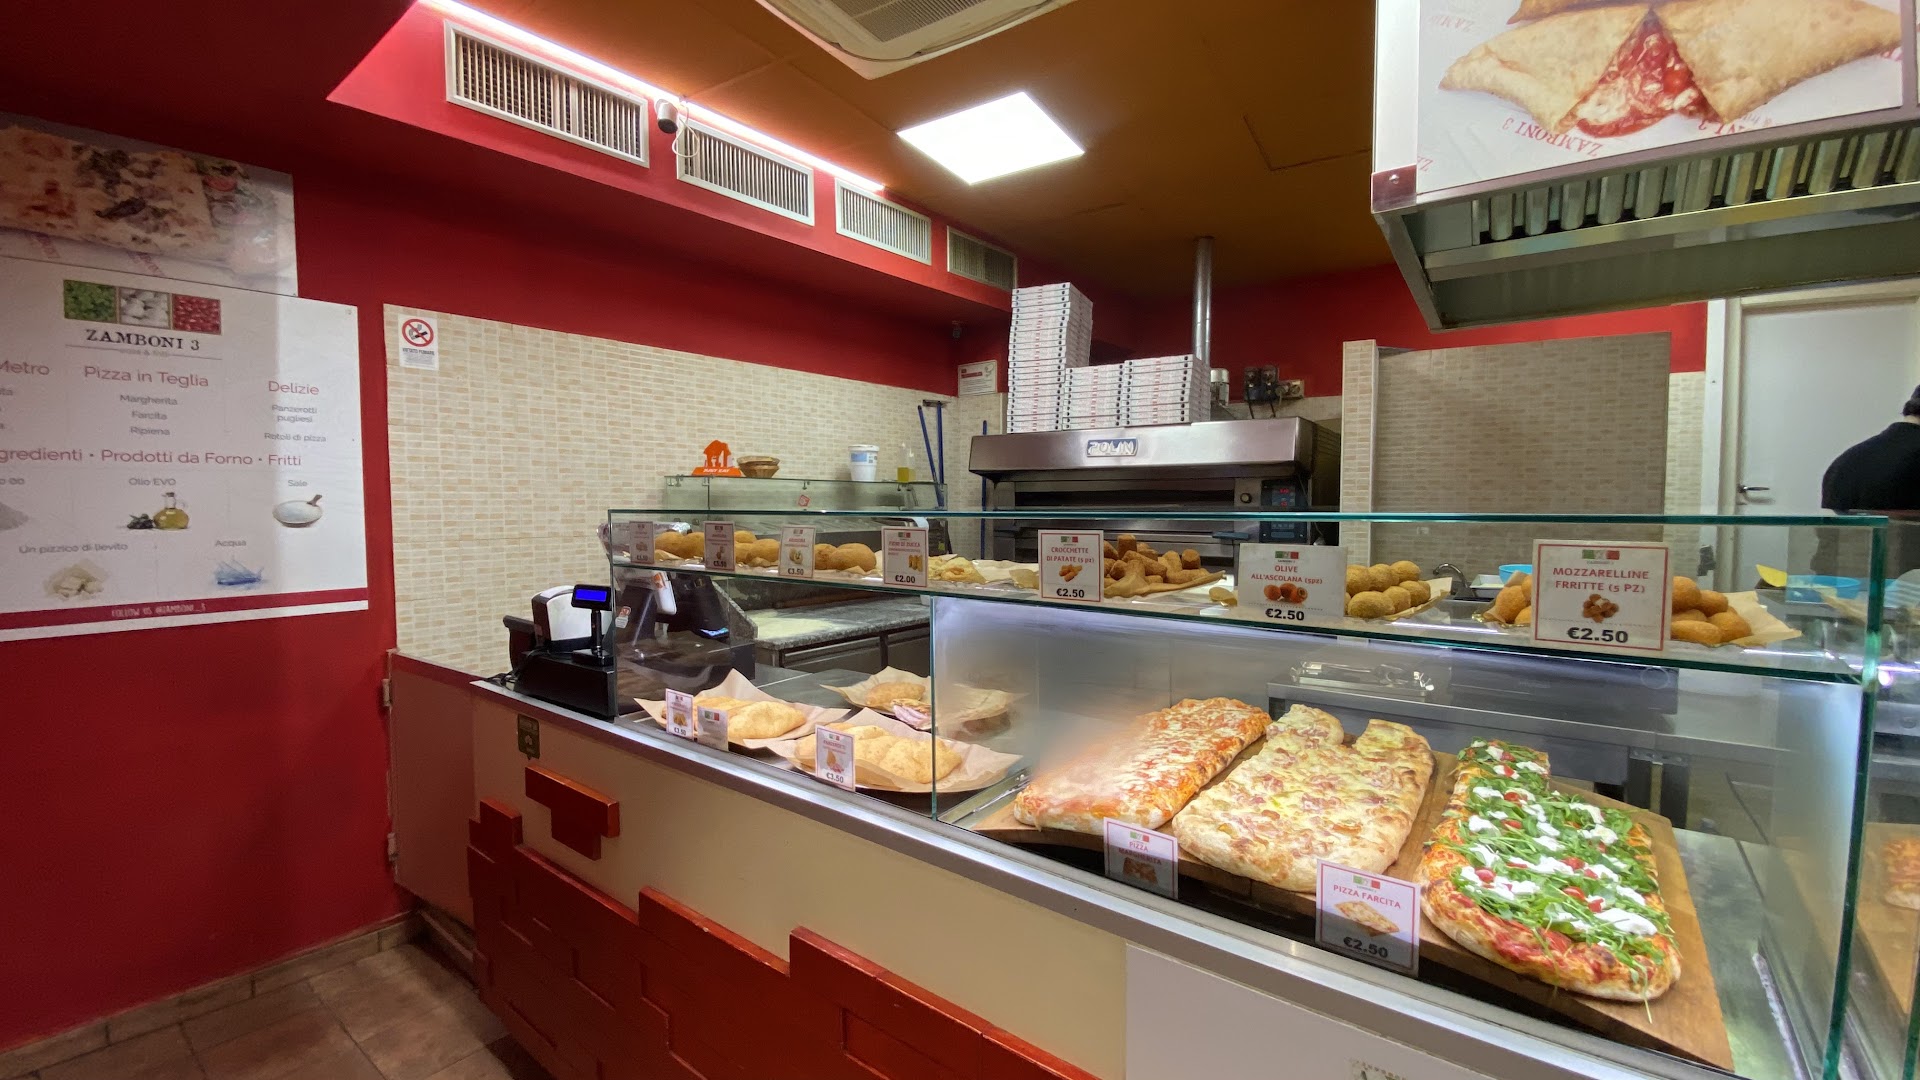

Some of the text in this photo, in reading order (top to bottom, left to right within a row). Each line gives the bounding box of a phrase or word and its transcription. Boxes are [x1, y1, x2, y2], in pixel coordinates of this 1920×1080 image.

[85, 328, 200, 351] ZAMBONI 3
[84, 365, 209, 389] Pizza in Teglia
[268, 380, 320, 396] Delizie
[120, 394, 178, 405] Margherita
[271, 404, 318, 414] Panzerotti
[131, 410, 168, 421] Farcita
[130, 425, 171, 436] Ripiena
[1088, 440, 1134, 455] POLIN
[101, 449, 173, 463] Prodotti
[178, 452, 200, 464] da
[205, 452, 254, 465] Forno
[268, 454, 302, 466] Fritti
[128, 477, 177, 486] Olio EVO
[287, 479, 308, 487] Sale
[214, 540, 247, 548] Acqua
[1051, 546, 1089, 554] CROCCHETTE
[1053, 555, 1077, 563] PATATE
[1274, 564, 1299, 573] OLIVE
[1552, 567, 1649, 580] MOZZARELLINE
[894, 574, 916, 584] €2.00
[1250, 573, 1303, 583] ALL'ASCOLANA
[1555, 580, 1646, 593] FRRITTE (5 PZ)
[1056, 587, 1085, 598] €2.50
[1264, 608, 1305, 621] €2.50
[1567, 627, 1629, 643] €2.50
[826, 772, 844, 783] €3.50
[1129, 841, 1149, 852] PIZZA
[1333, 884, 1360, 898] PIZZA
[1361, 892, 1402, 909] FARCITA
[1343, 936, 1389, 959] €2.50
